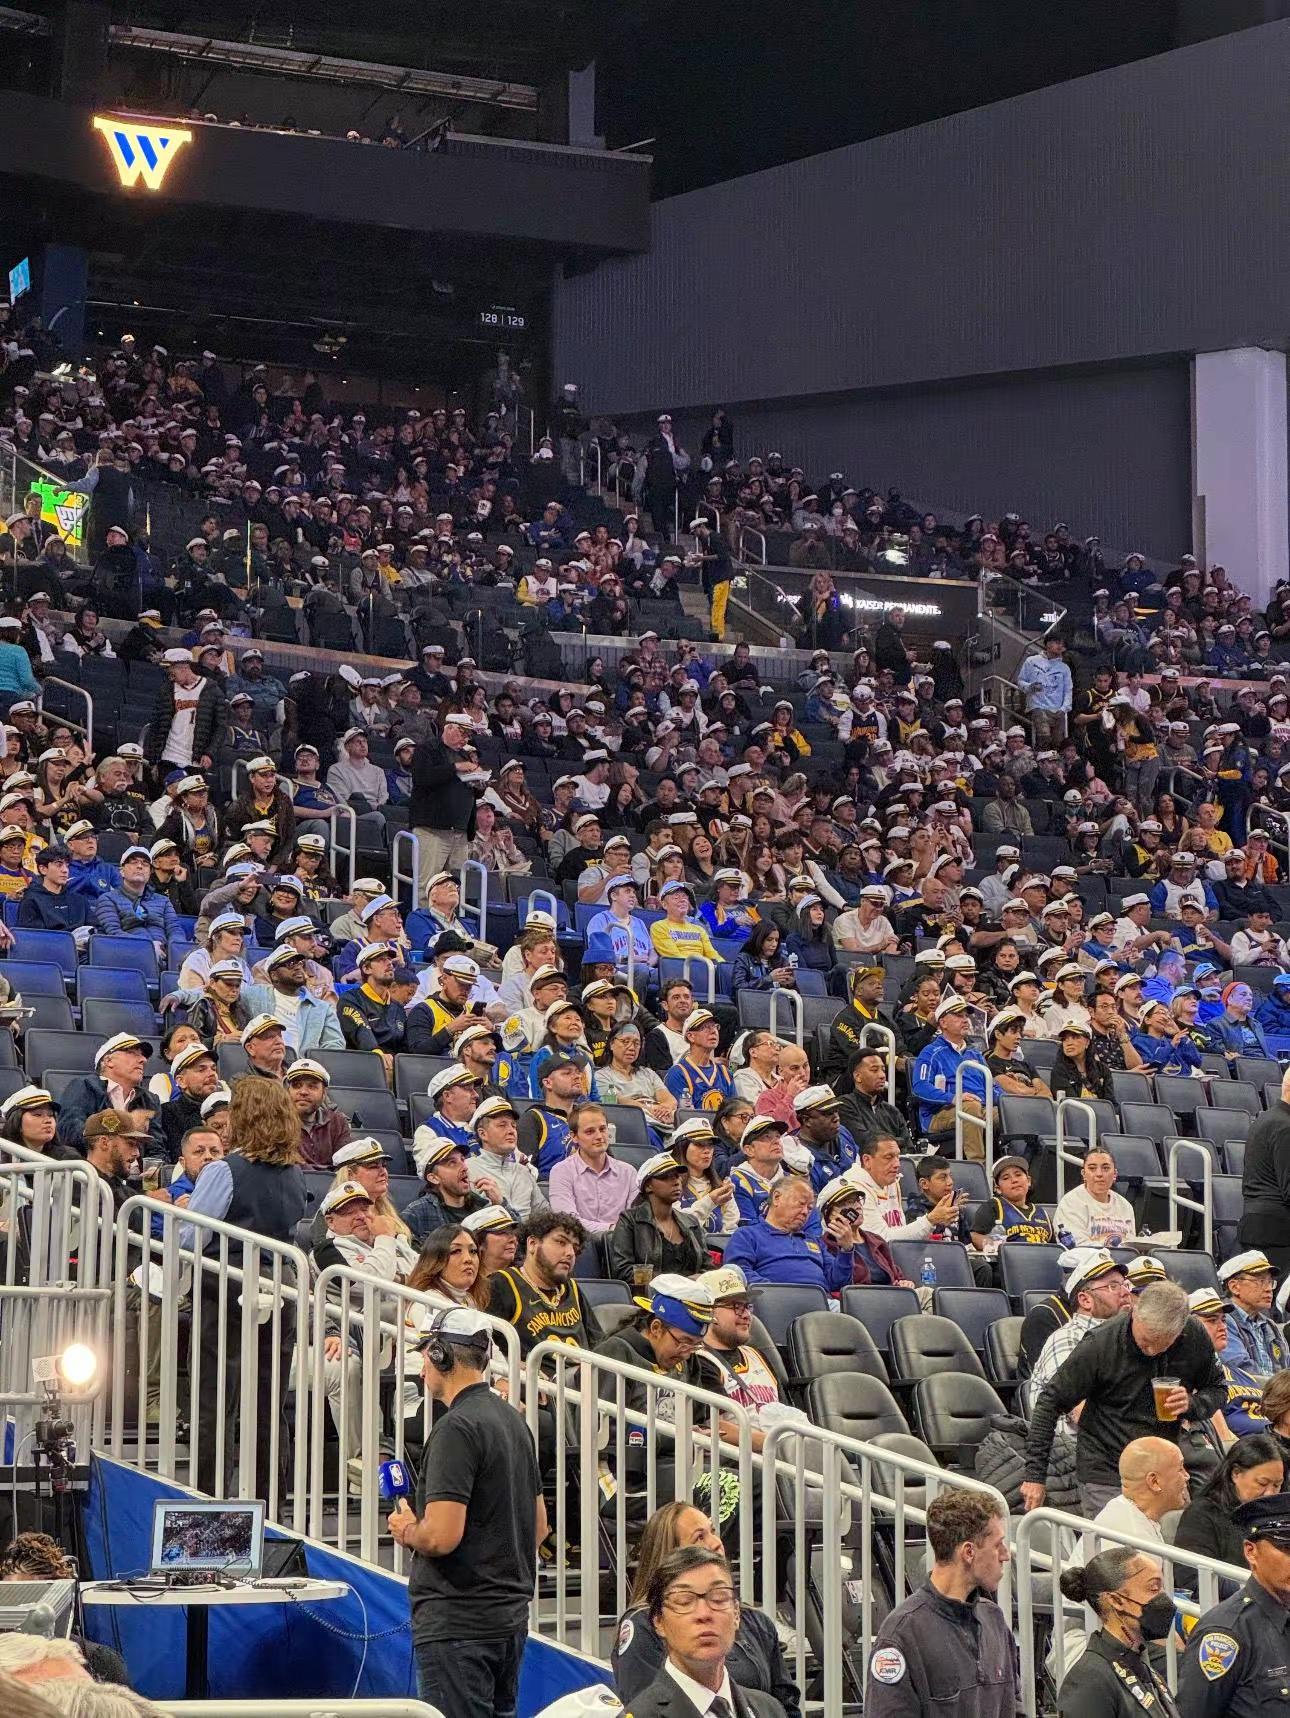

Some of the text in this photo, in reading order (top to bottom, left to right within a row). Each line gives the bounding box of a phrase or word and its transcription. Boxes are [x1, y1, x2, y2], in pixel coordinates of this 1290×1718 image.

[480, 312, 525, 326] 128 129
[856, 600, 883, 610] KAISER
